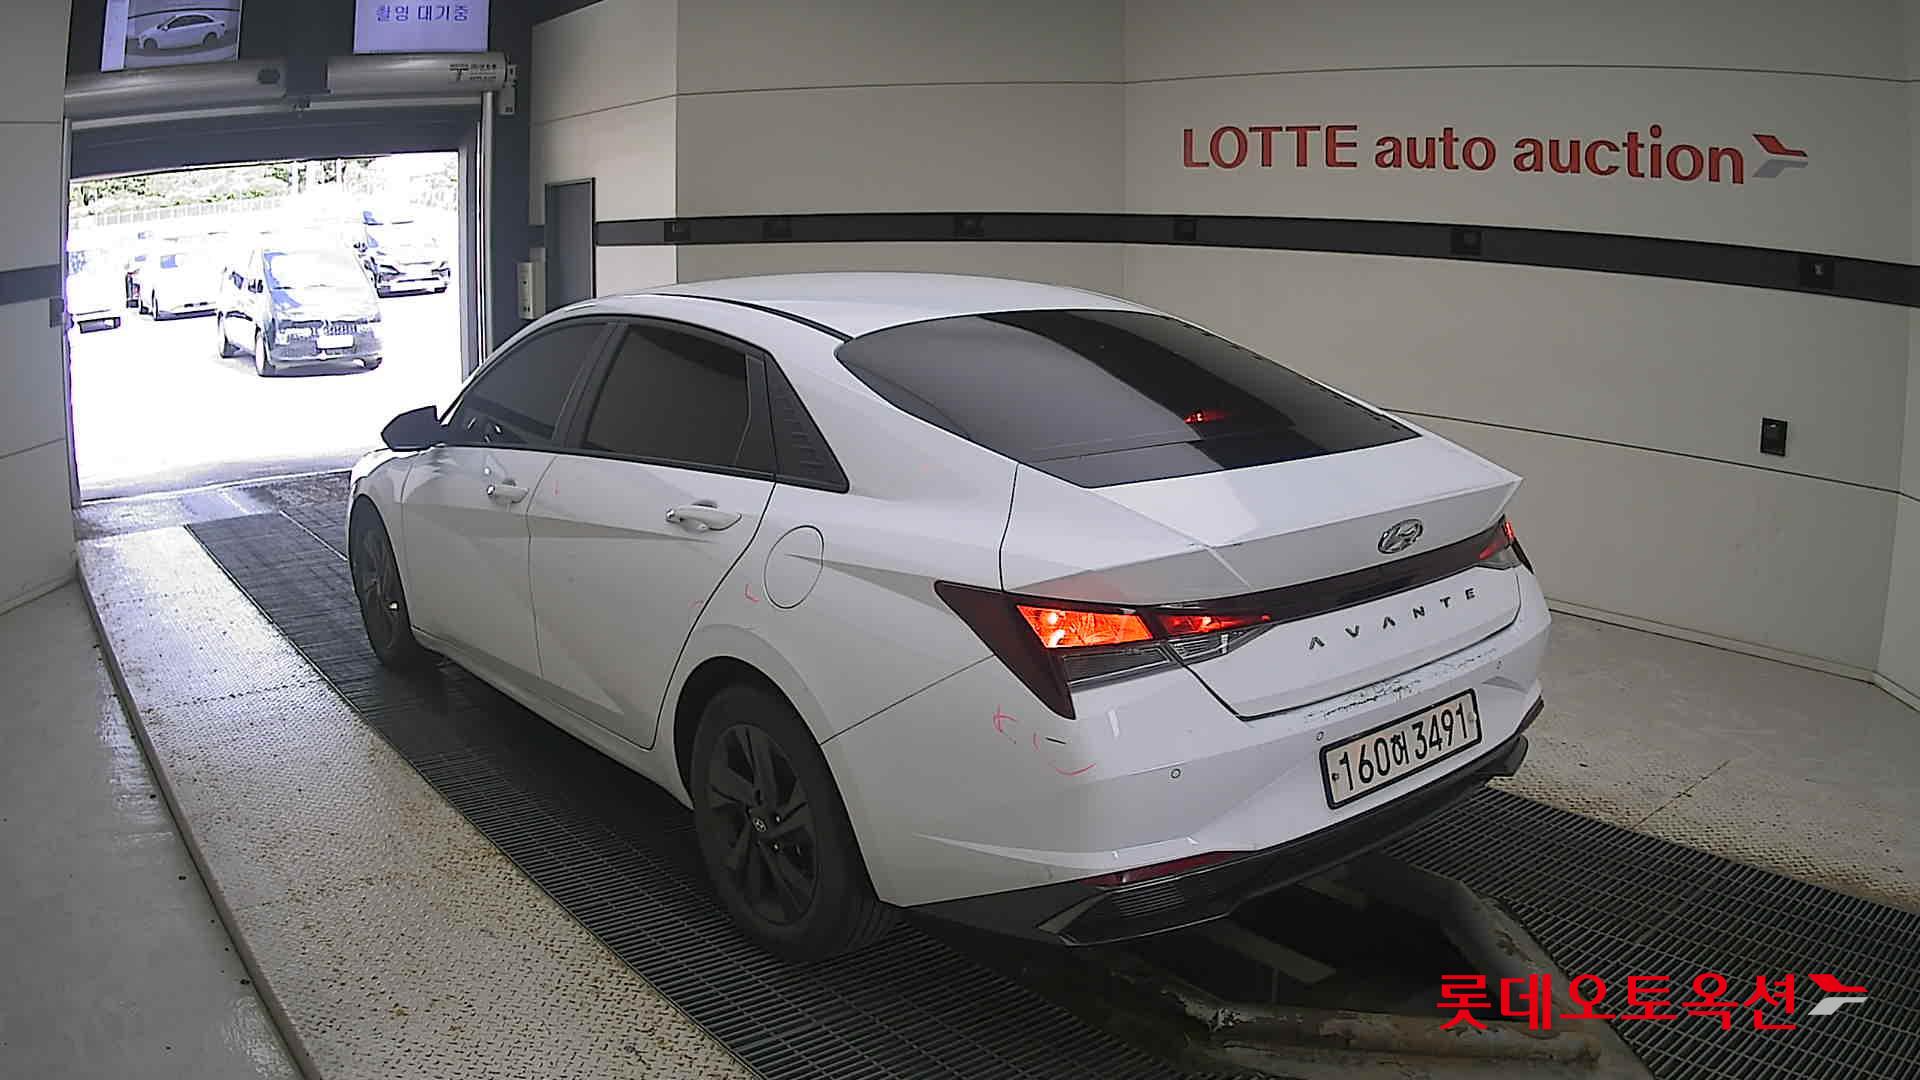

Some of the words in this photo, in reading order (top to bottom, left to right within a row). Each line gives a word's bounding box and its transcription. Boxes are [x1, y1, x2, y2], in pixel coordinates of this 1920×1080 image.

[418, 4, 469, 21] 대기중
[1183, 126, 1357, 168] LOTTE
[1376, 127, 1496, 170] auto
[1513, 124, 1745, 184] auction
[1309, 587, 1477, 650] AVANTE
